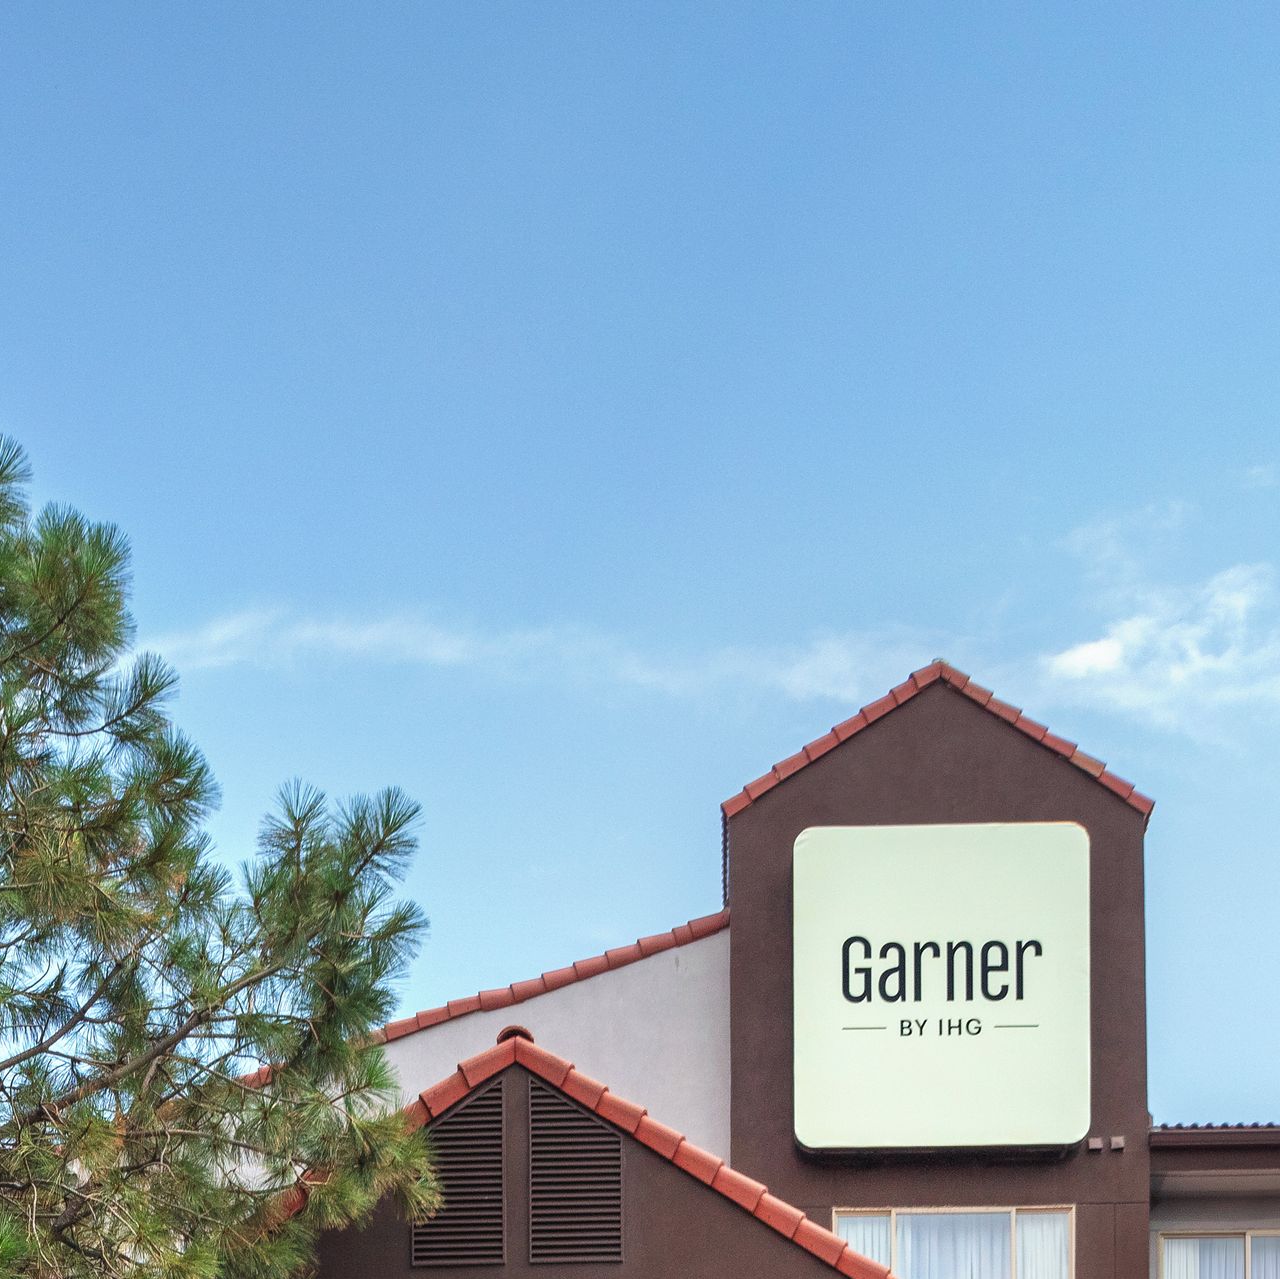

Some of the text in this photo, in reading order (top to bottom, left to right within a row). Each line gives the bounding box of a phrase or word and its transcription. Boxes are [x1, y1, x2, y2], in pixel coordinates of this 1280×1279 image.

[841, 936, 1043, 1003] Garner
[899, 1018, 983, 1036] BY IHG
